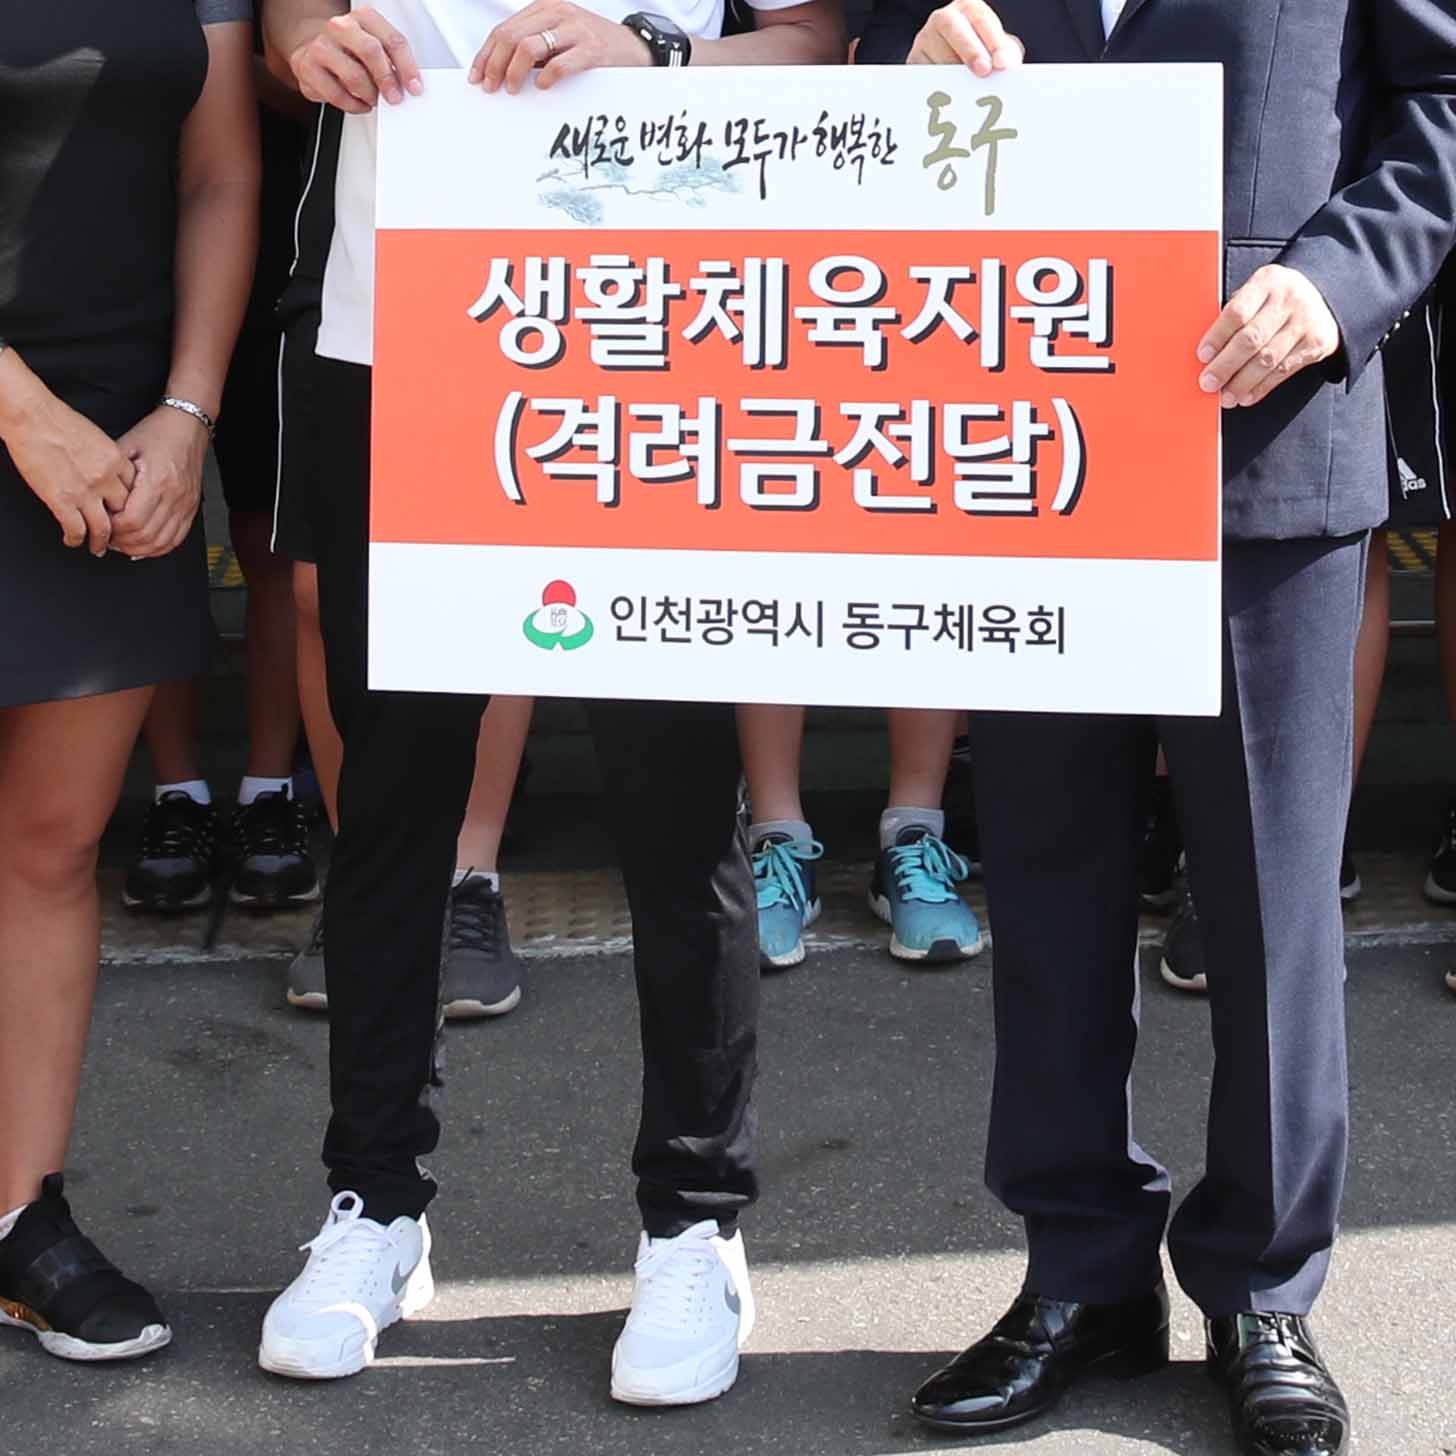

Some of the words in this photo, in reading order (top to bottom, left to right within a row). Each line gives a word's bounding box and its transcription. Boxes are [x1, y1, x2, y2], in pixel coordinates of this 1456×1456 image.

[549, 113, 634, 179] 새로운
[640, 108, 713, 168] 변화
[721, 116, 809, 200] 모두가
[813, 109, 898, 186] 행복한
[922, 90, 1018, 216] 동구
[467, 254, 1116, 374] 생활체육지원
[494, 390, 1086, 517] (격려금전달)
[609, 595, 825, 649] 인천광역시
[841, 601, 1066, 655] 동구체육회
